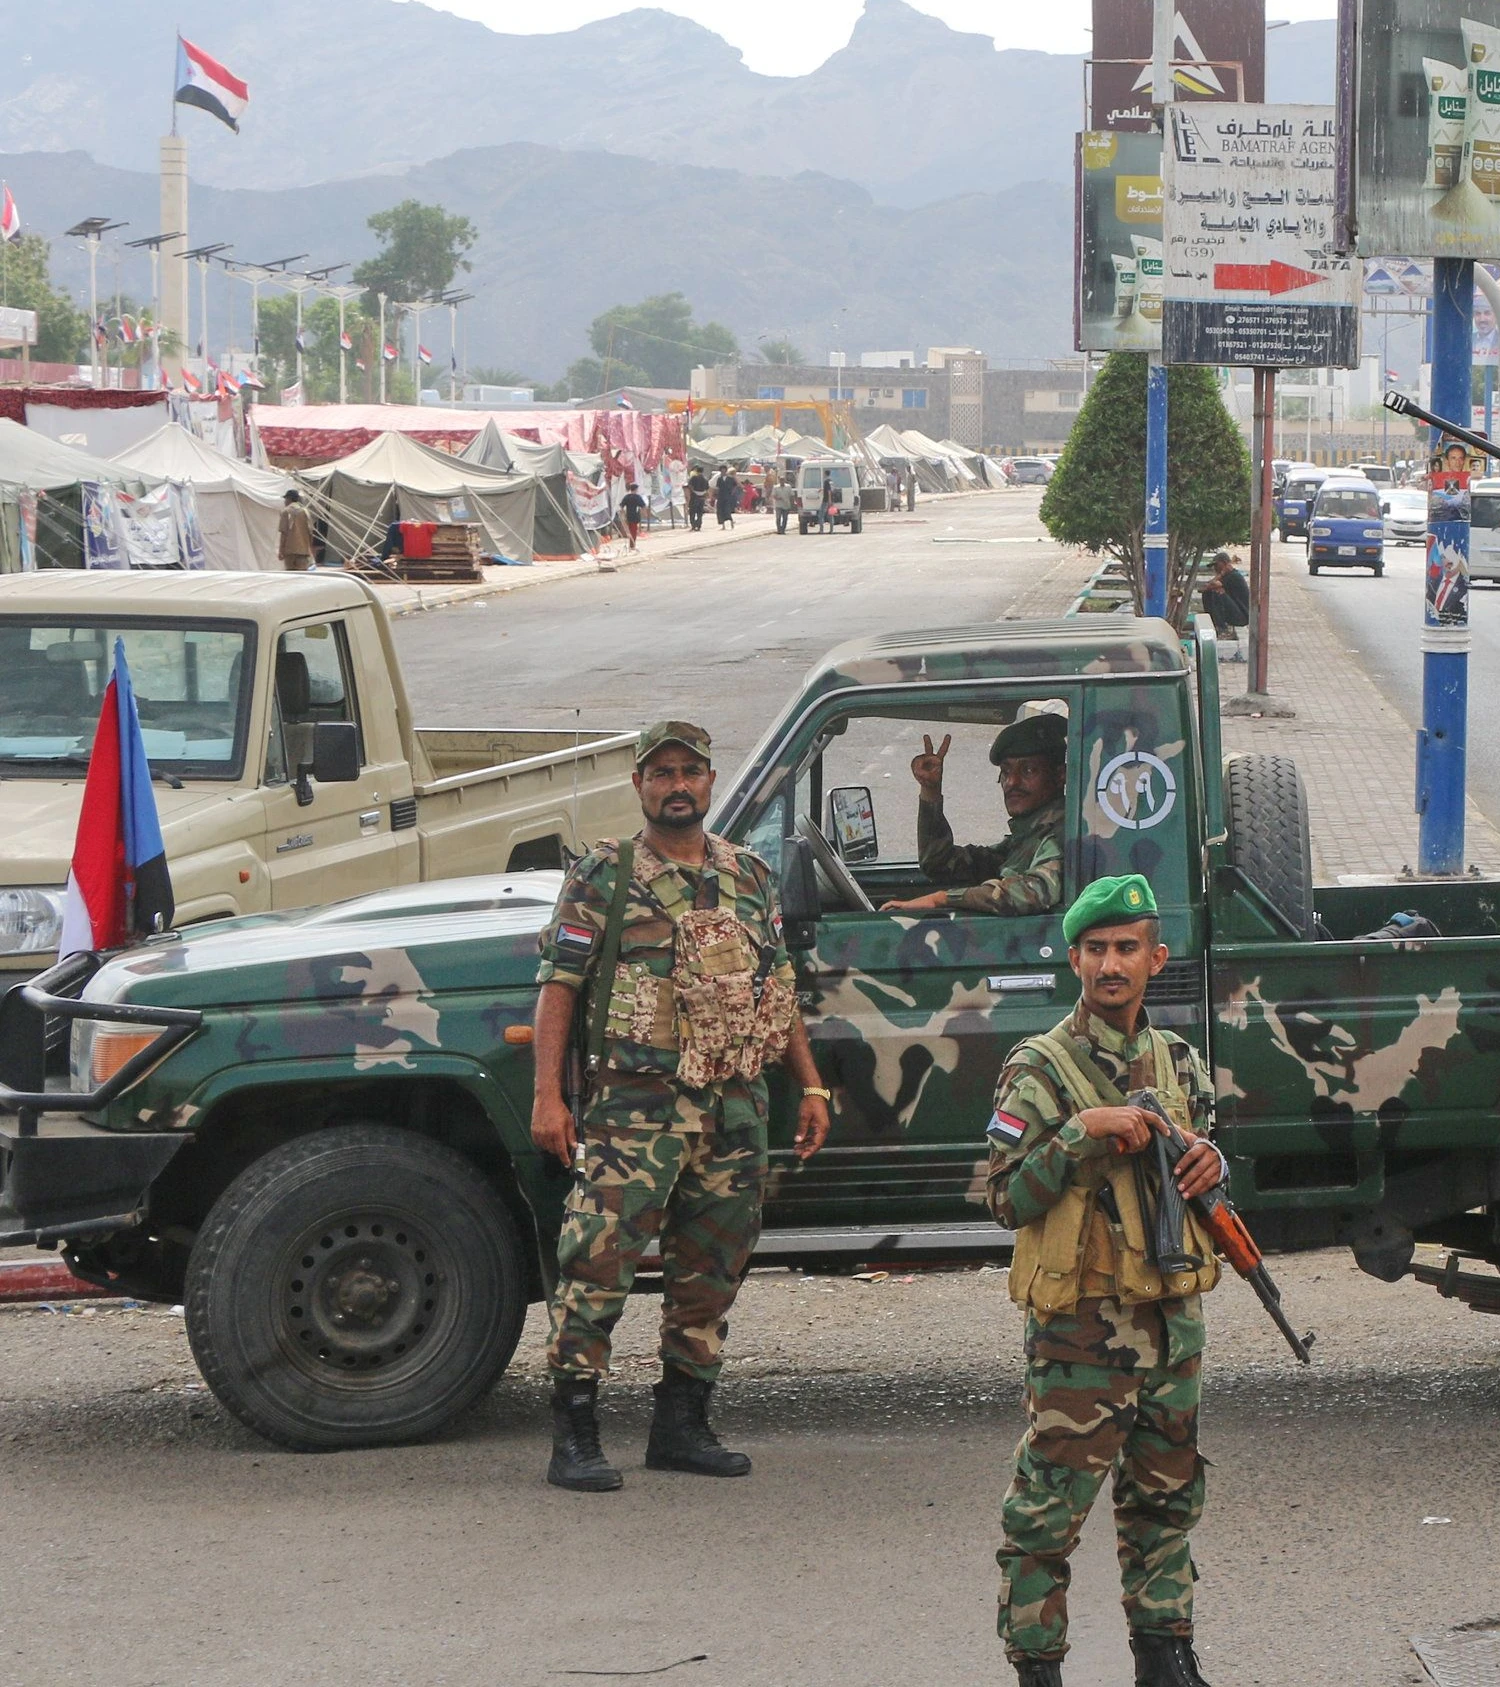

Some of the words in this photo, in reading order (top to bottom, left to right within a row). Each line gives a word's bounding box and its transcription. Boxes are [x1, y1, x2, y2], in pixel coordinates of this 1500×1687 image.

[1107, 105, 1151, 126] سلامي
[1222, 139, 1295, 153] BAMATRAF
[1300, 142, 1335, 154] AGEN
[1184, 248, 1214, 258] (59)
[1311, 260, 1350, 271] IATA
